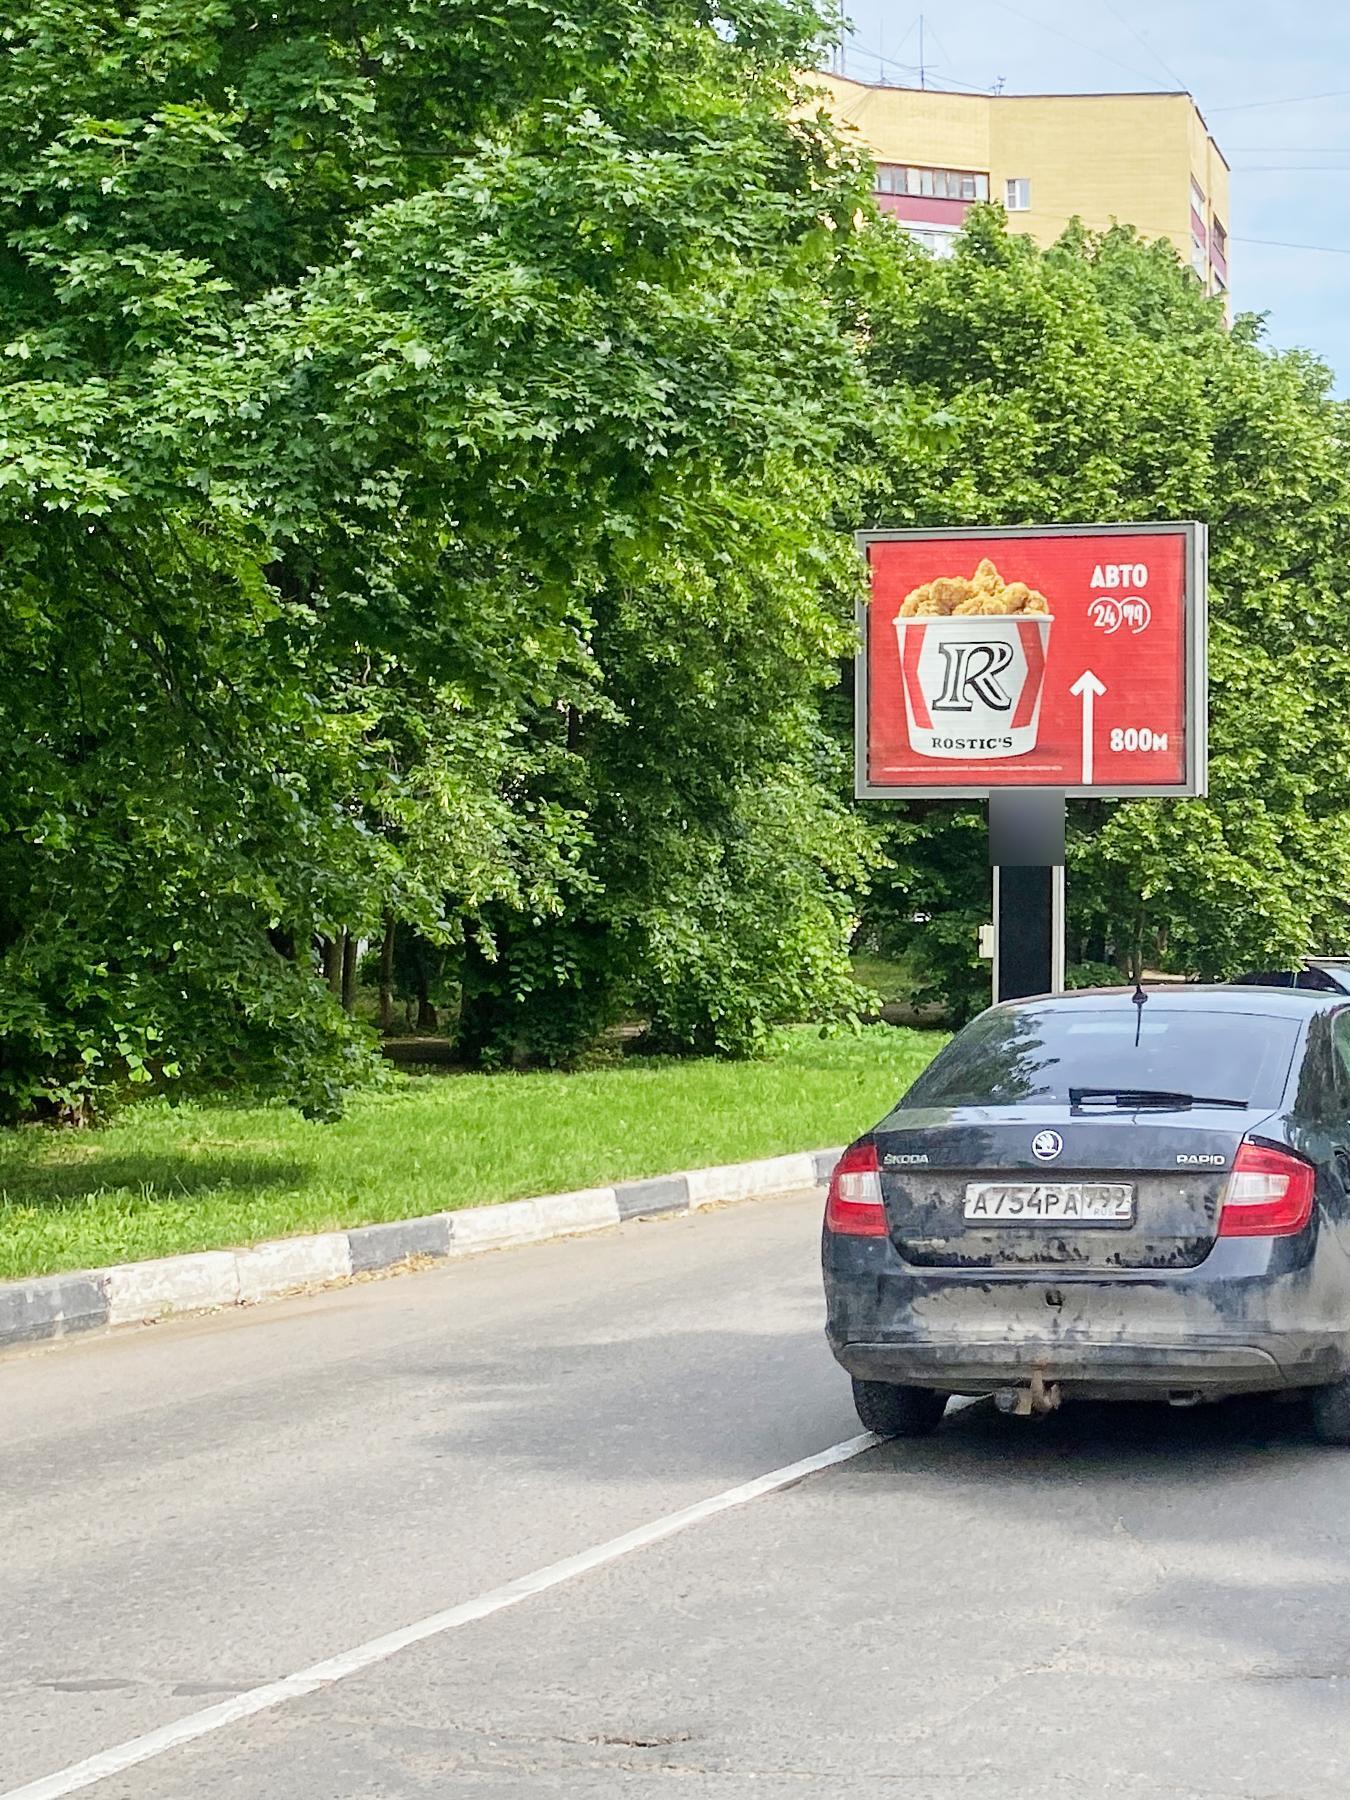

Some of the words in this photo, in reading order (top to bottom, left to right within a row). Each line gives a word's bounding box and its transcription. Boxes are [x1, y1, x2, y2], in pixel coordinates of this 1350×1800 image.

[1090, 563, 1148, 588] АВТО
[1093, 604, 1117, 627] 24
[931, 736, 1013, 750] ROSTIC'S
[1176, 1154, 1225, 1166] RAPID
